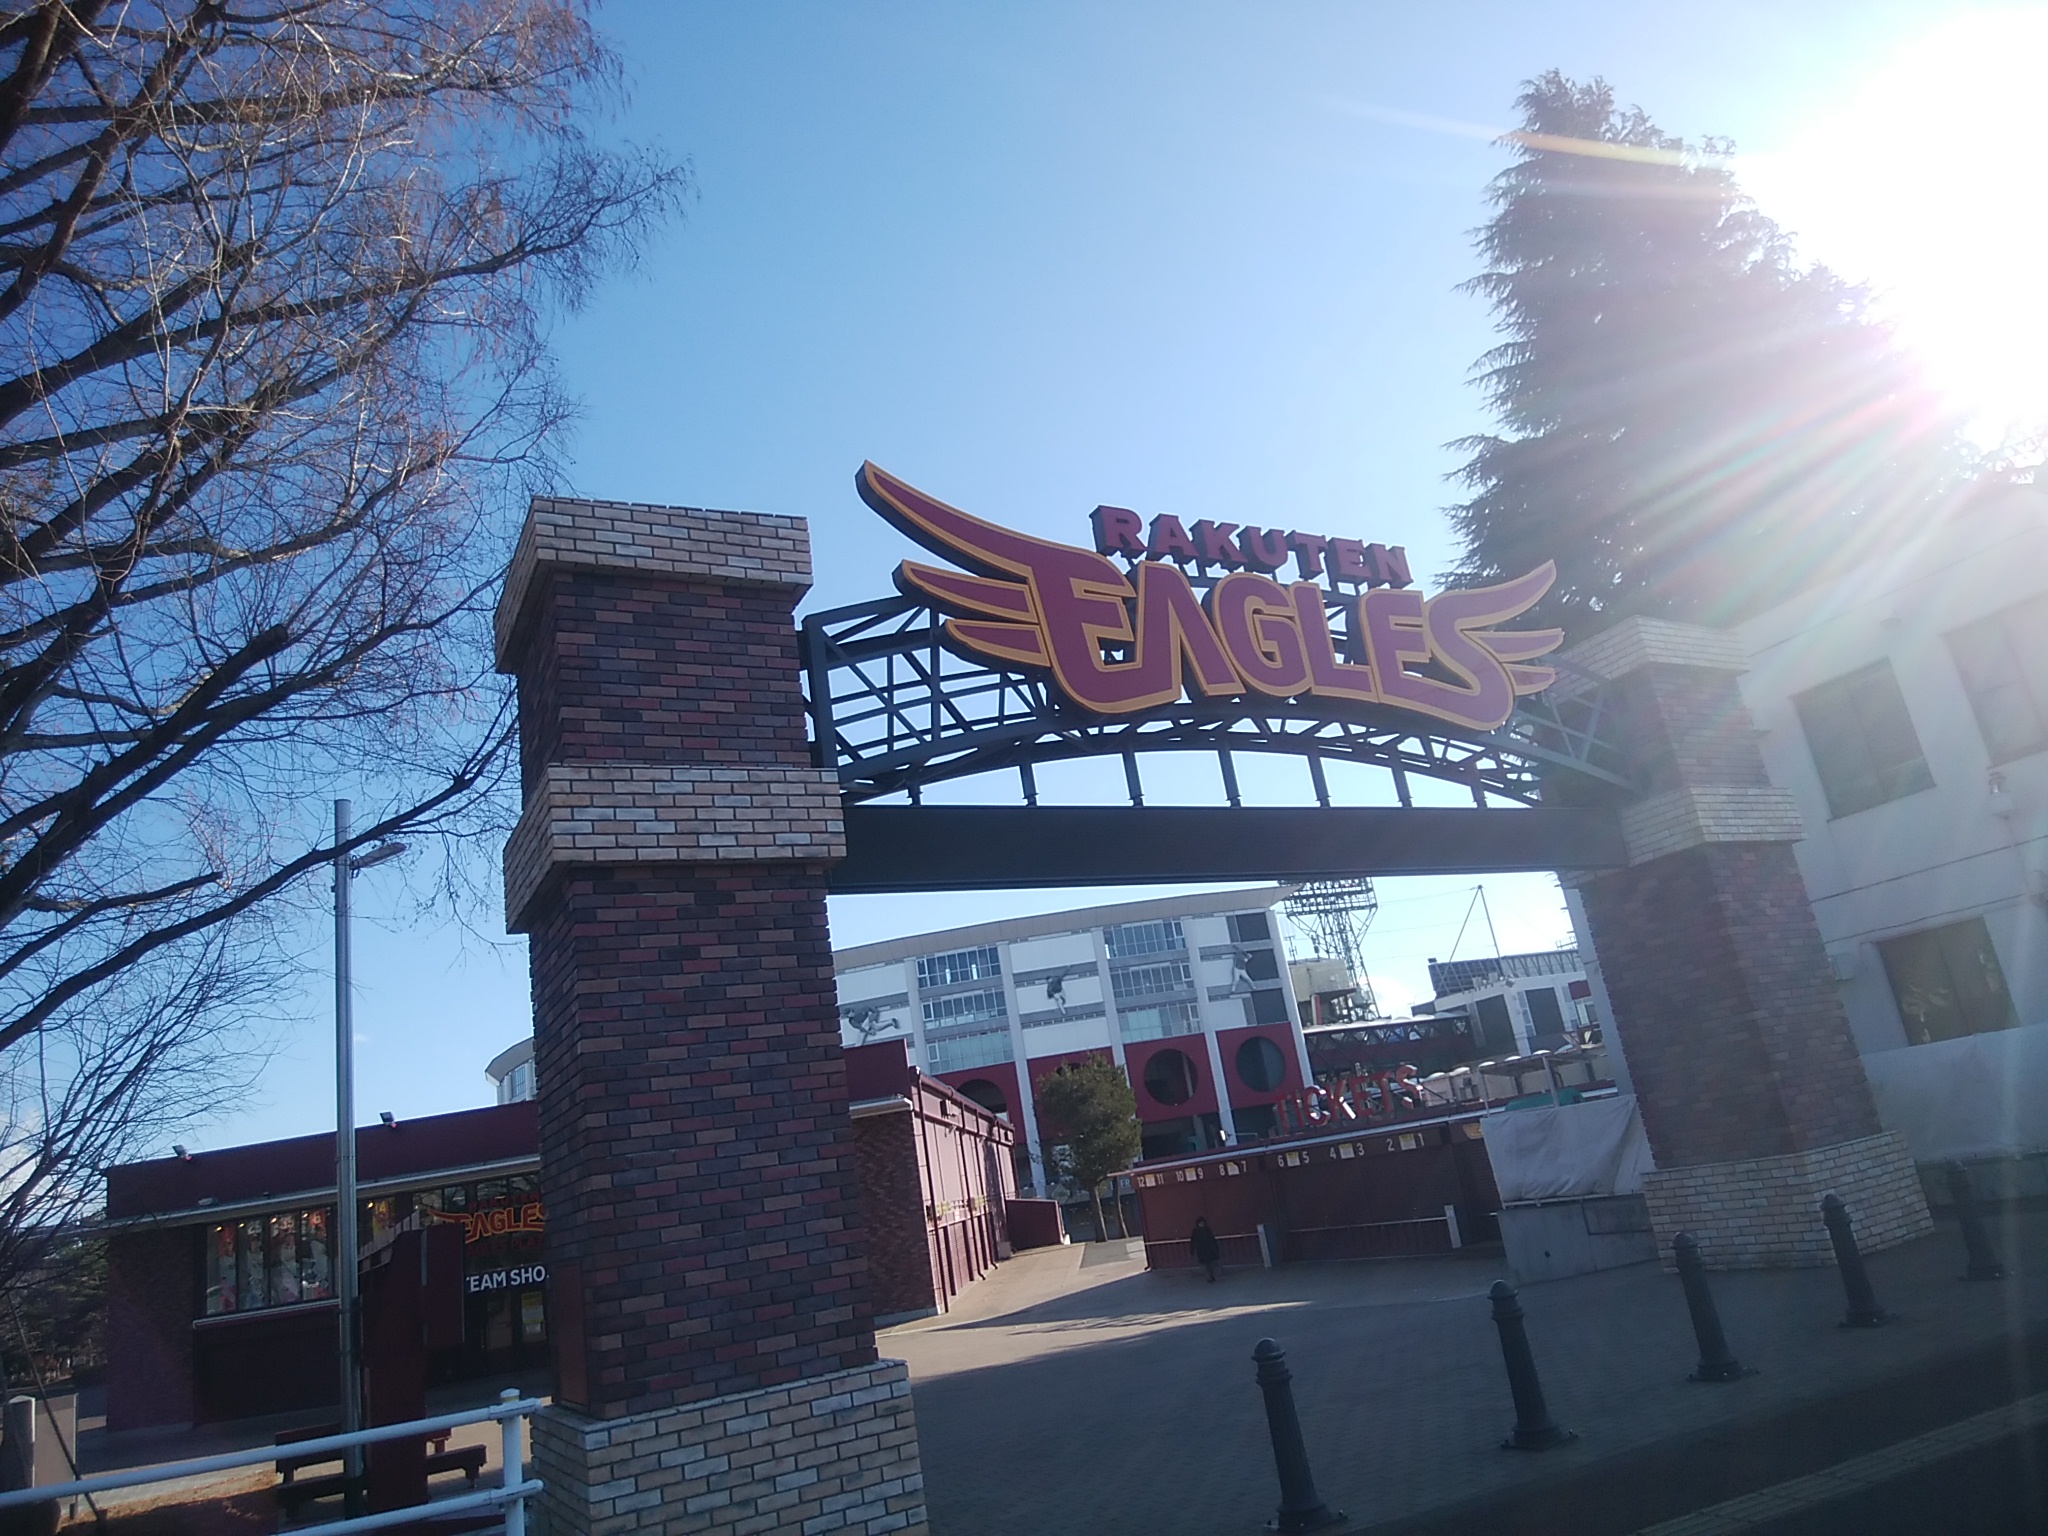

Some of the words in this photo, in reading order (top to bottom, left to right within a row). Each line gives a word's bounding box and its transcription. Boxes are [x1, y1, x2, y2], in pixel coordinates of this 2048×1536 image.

[1089, 504, 1413, 588] RAKUTEN
[856, 460, 1565, 732] EAGLES
[1268, 1062, 1423, 1132] TICKETS
[1137, 1176, 1146, 1188] 12
[1156, 1173, 1165, 1185] 11
[1175, 1171, 1185, 1182] 10
[1197, 1167, 1204, 1179] 9
[1219, 1164, 1226, 1176] 8
[1241, 1160, 1248, 1173] 7
[1277, 1154, 1285, 1168] 6
[1302, 1150, 1310, 1164] 5
[1329, 1147, 1337, 1160] 4
[1357, 1143, 1365, 1157] 3
[1386, 1138, 1395, 1152] 2
[1418, 1133, 1425, 1146] 1
[466, 1270, 508, 1293] EAM
[510, 1265, 550, 1287] SHO
